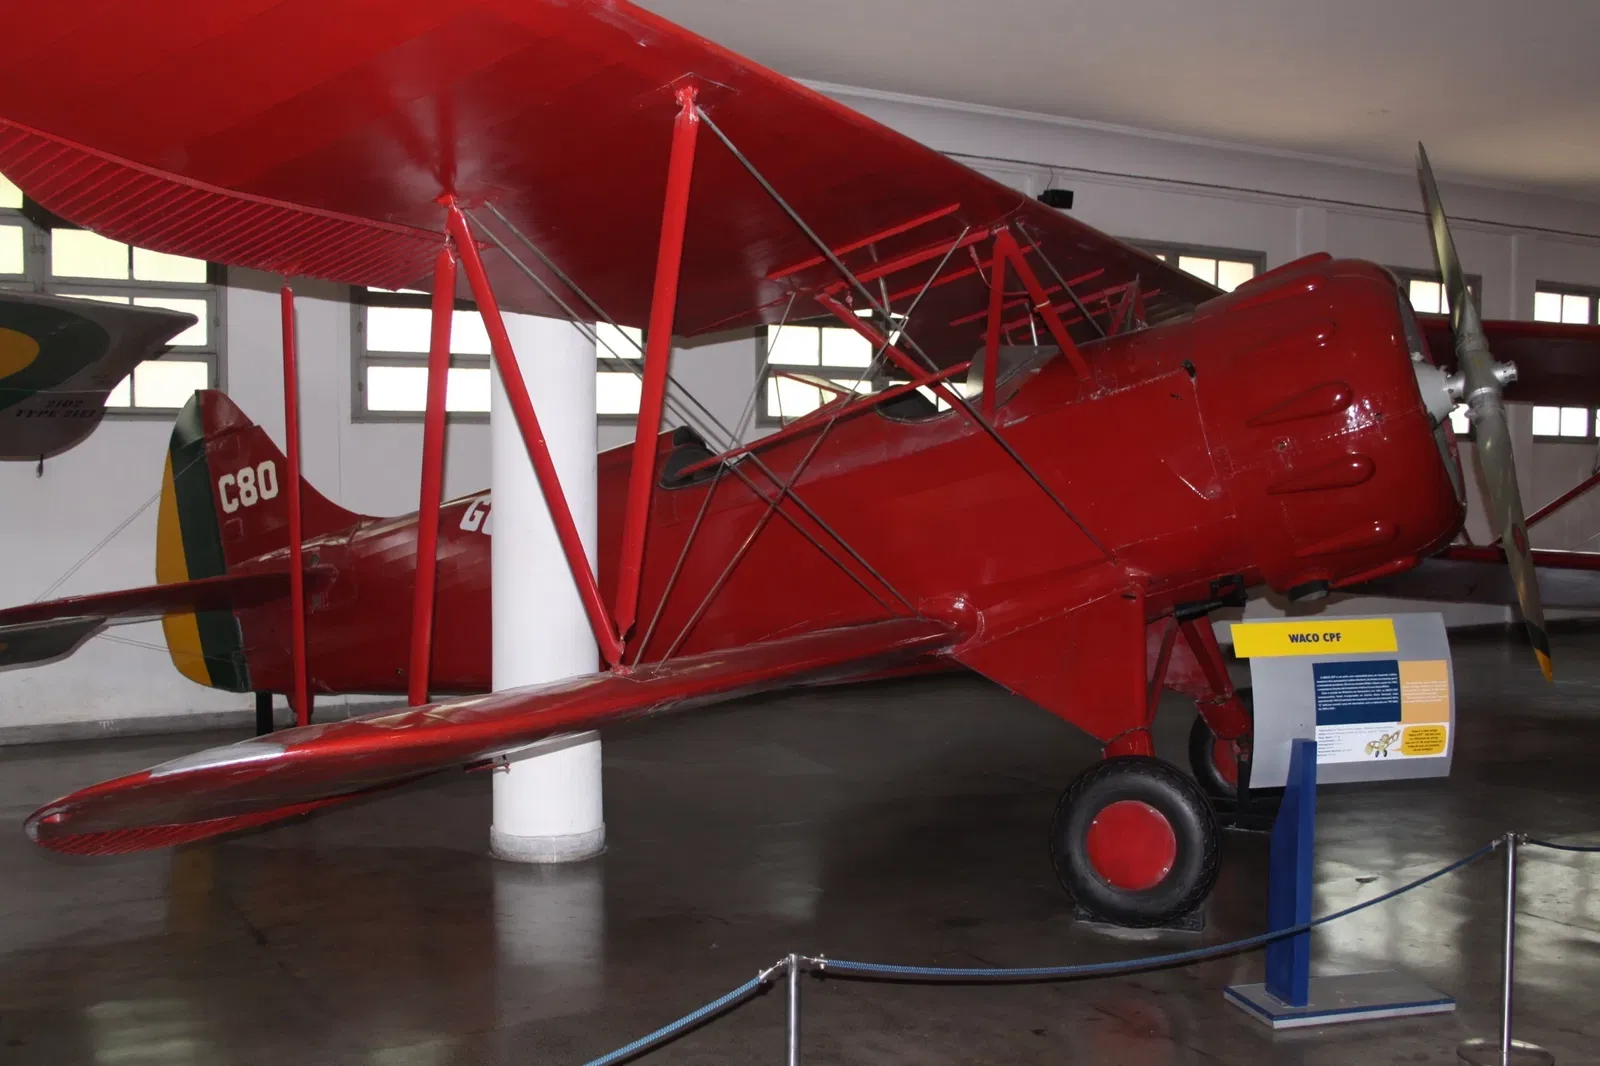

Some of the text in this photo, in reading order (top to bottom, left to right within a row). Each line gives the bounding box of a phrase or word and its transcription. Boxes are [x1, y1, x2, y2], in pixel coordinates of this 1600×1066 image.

[15, 409, 59, 418] TYPE
[218, 460, 279, 514] C80
[1288, 632, 1342, 643] WACO CPF
